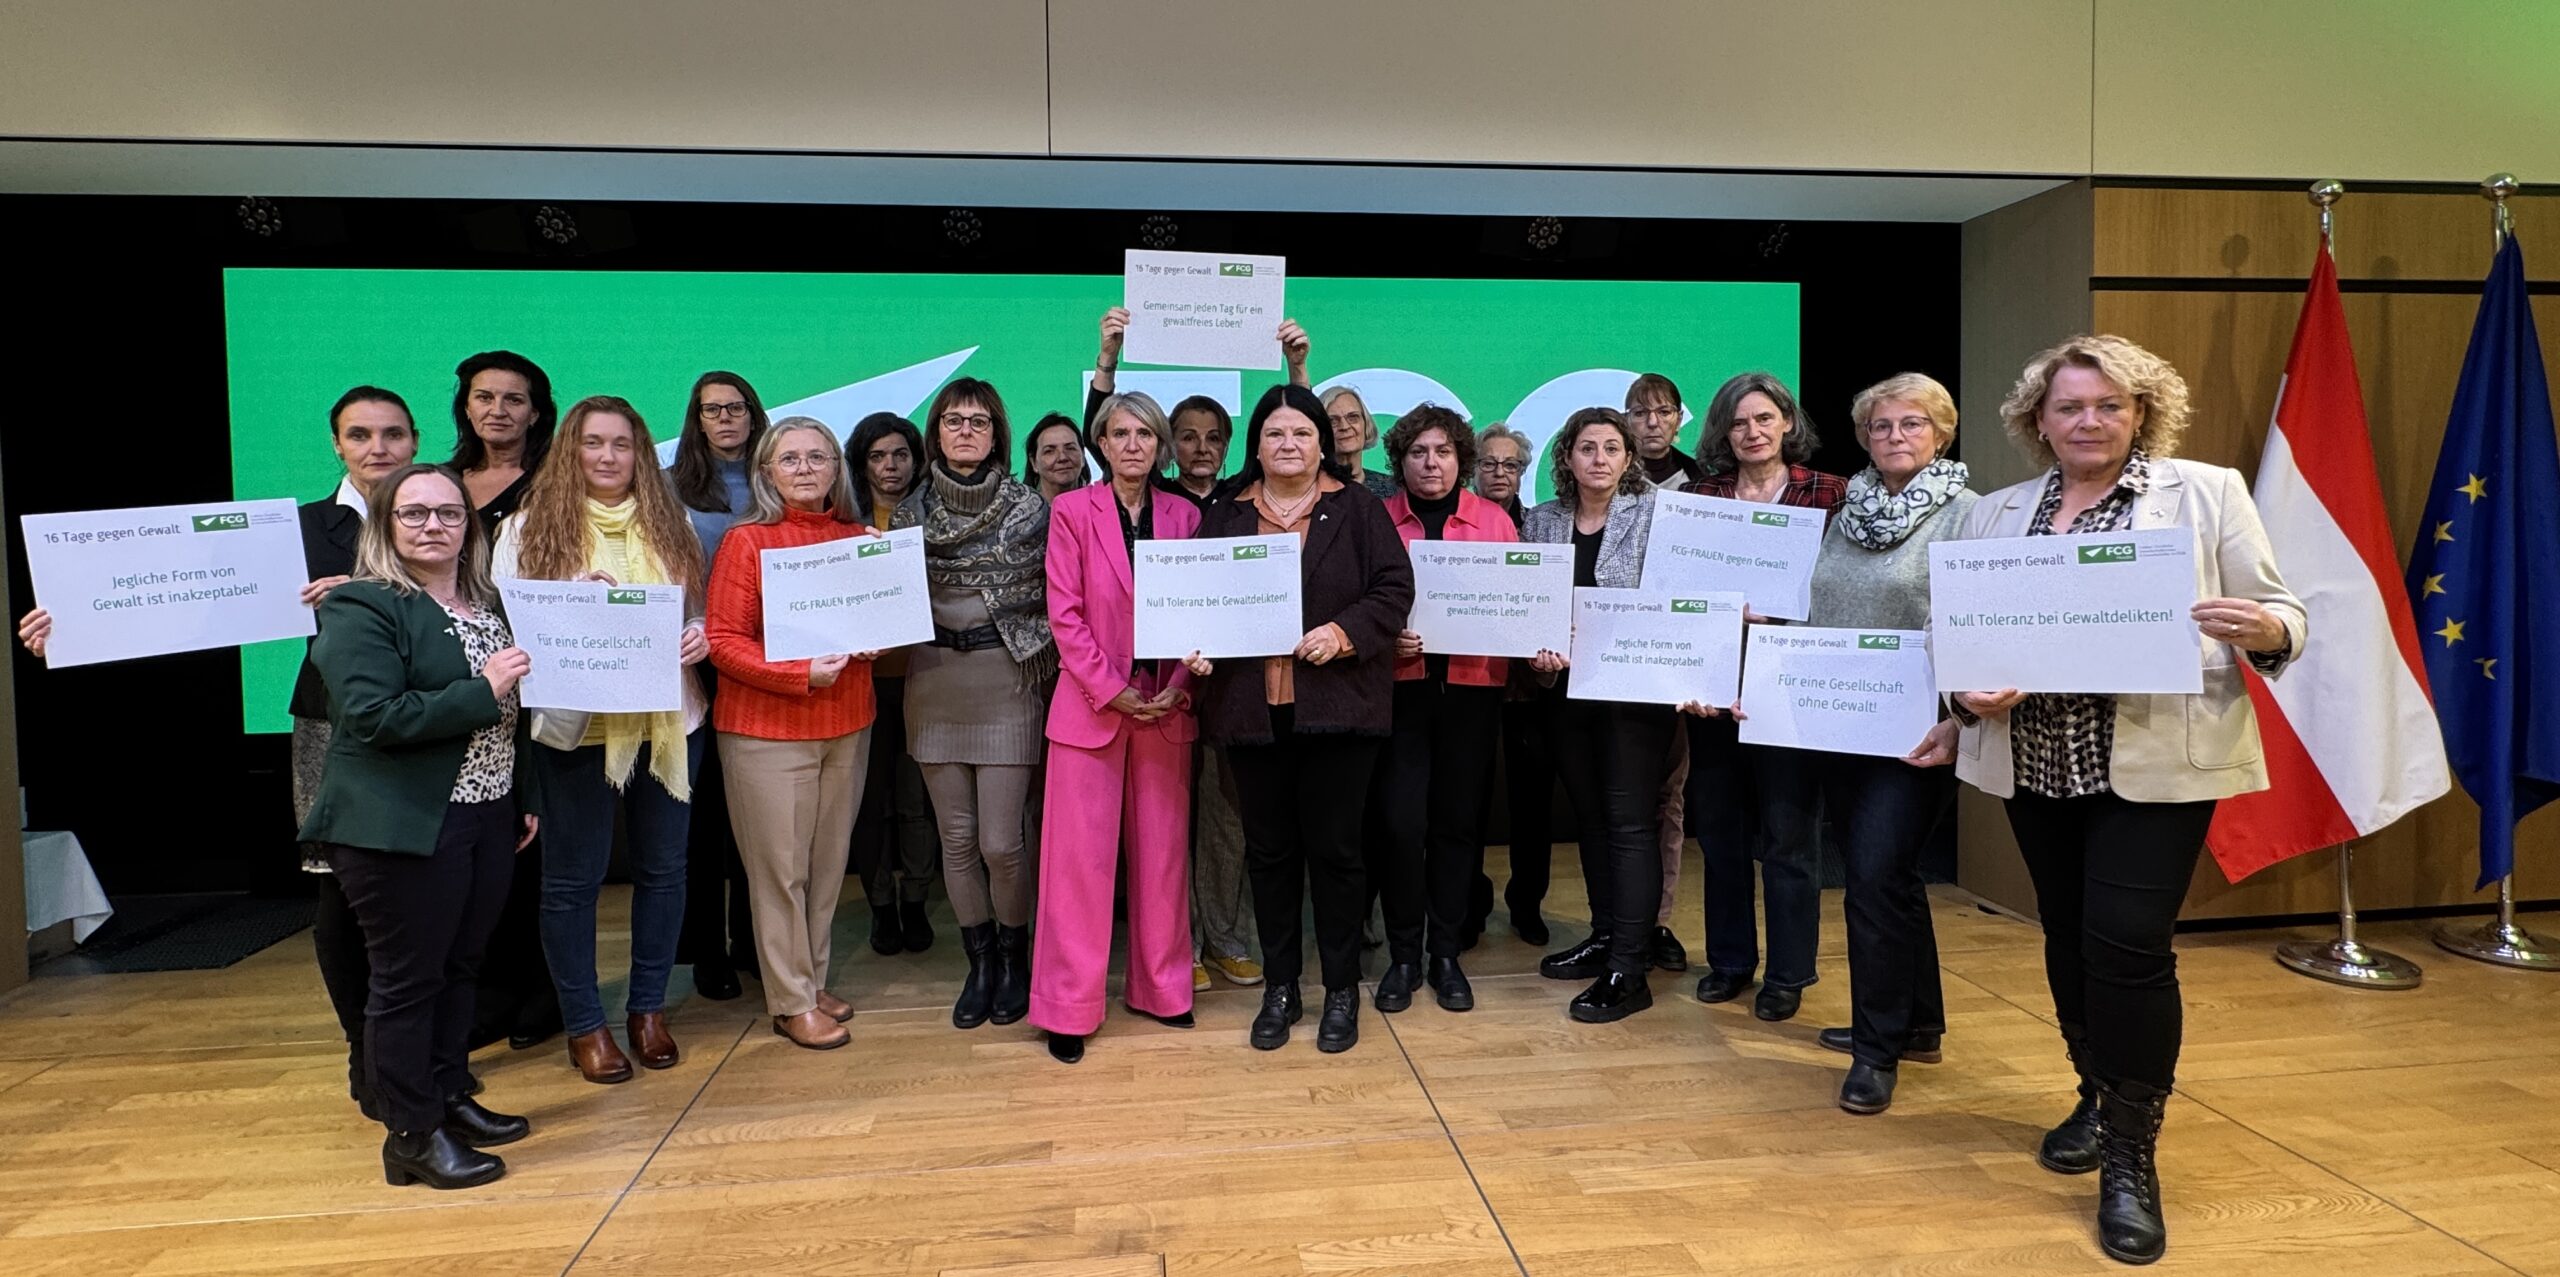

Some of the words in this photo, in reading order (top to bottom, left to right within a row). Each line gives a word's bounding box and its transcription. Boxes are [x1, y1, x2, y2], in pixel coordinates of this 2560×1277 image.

[1135, 264, 1143, 273] 16
[1146, 264, 1162, 274] Tage
[1164, 266, 1185, 276] gegen
[1187, 266, 1212, 276] Gewalt
[1143, 300, 1192, 312] Gemeinsam
[1193, 303, 1217, 314] jeden
[1219, 303, 1234, 316] Tag
[1235, 304, 1248, 314] für
[1249, 305, 1263, 315] ein
[1162, 317, 1213, 328] gewaltfreies
[1215, 318, 1243, 328] Leben!
[219, 514, 245, 525] FCG
[1665, 504, 1673, 512] 16
[1675, 505, 1692, 515] Tage
[1693, 508, 1716, 519] gegen
[1718, 511, 1744, 522] Gewalt
[1769, 514, 1787, 522] FCG
[44, 533, 59, 544] 16
[62, 530, 93, 544] Tage
[97, 527, 135, 542] gegen
[138, 524, 181, 538] Gewalt
[873, 541, 889, 550] FCG
[1249, 546, 1266, 554] FCG
[2106, 546, 2133, 556] FCG
[772, 562, 781, 571] 16
[783, 561, 801, 571] Tage
[803, 558, 826, 570] gegen
[827, 553, 851, 563] Gewalt
[1145, 555, 1154, 563] 16
[1156, 554, 1173, 565] Tage
[1175, 554, 1197, 565] gegen
[1199, 552, 1225, 562] Gewalt
[1419, 554, 1427, 563] 16
[1429, 554, 1446, 564] Tage
[1448, 555, 1470, 565] gegen
[1472, 555, 1497, 564] Gewalt
[1671, 545, 1724, 562] FCG-FRAUEN
[1725, 555, 1752, 566] gegen
[1754, 557, 1789, 570] Gewalt!
[1944, 560, 1957, 570] 16
[1959, 558, 1985, 572] Tage
[1988, 558, 2022, 571] gegen
[2025, 554, 2065, 567] Gewalt
[112, 572, 168, 590] Jegliche
[172, 569, 207, 582] Form
[211, 566, 236, 578] von
[93, 595, 143, 612] Gewalt
[147, 592, 165, 606] ist
[168, 583, 259, 603] inakzeptabel!
[507, 590, 516, 599] 16
[517, 590, 535, 601] Tage
[537, 593, 564, 605] gegen
[566, 593, 597, 604] Gewalt
[626, 591, 644, 599] FCG
[789, 596, 844, 612] FCG-FRAUEN
[845, 592, 871, 606] gegen
[872, 586, 902, 600] Gewalt!
[1146, 597, 1164, 607] Null
[1167, 597, 1204, 607] Toleranz
[1206, 595, 1220, 606] bei
[1222, 592, 1288, 606] Gewaltdelikten!
[1427, 590, 1477, 601] Gemeinsam
[1478, 592, 1503, 603] jeden
[1504, 592, 1519, 604] Tag
[1521, 592, 1534, 603] für
[1536, 594, 1550, 603] ein
[1447, 605, 1498, 617] gewaltfreies
[1500, 607, 1529, 617] Leben!
[1584, 601, 1592, 609] 16
[1594, 601, 1611, 611] Tage
[1612, 603, 1635, 613] gegen
[1636, 603, 1663, 612] Gewalt
[1688, 601, 1706, 609] FCG
[1949, 614, 1975, 627] Null
[1977, 614, 2034, 626] Toleranz
[2038, 612, 2059, 625] bei
[2063, 609, 2174, 625] Gewaltdelikten!
[537, 633, 552, 647] Für
[555, 635, 578, 648] eine
[581, 636, 652, 649] Gesellschaft
[1614, 638, 1648, 649] Jegliche
[1651, 639, 1673, 650] Form
[1675, 641, 1692, 650] von
[1758, 635, 1767, 644] 16
[1769, 635, 1788, 647] Tage
[1790, 638, 1816, 648] gegen
[1818, 637, 1848, 648] Gewalt
[1879, 637, 1898, 645] FCG
[559, 657, 585, 670] ohne
[587, 657, 629, 670] Gewalt!
[1600, 653, 1629, 664] Gewalt
[1631, 654, 1643, 664] ist
[1644, 655, 1704, 667] inakzeptabel!
[1778, 674, 1798, 686] Für
[1800, 675, 1825, 689] eine
[1829, 678, 1905, 694] Gesellschaft
[1798, 696, 1829, 709] ohne
[1832, 698, 1877, 713] Gewalt!
